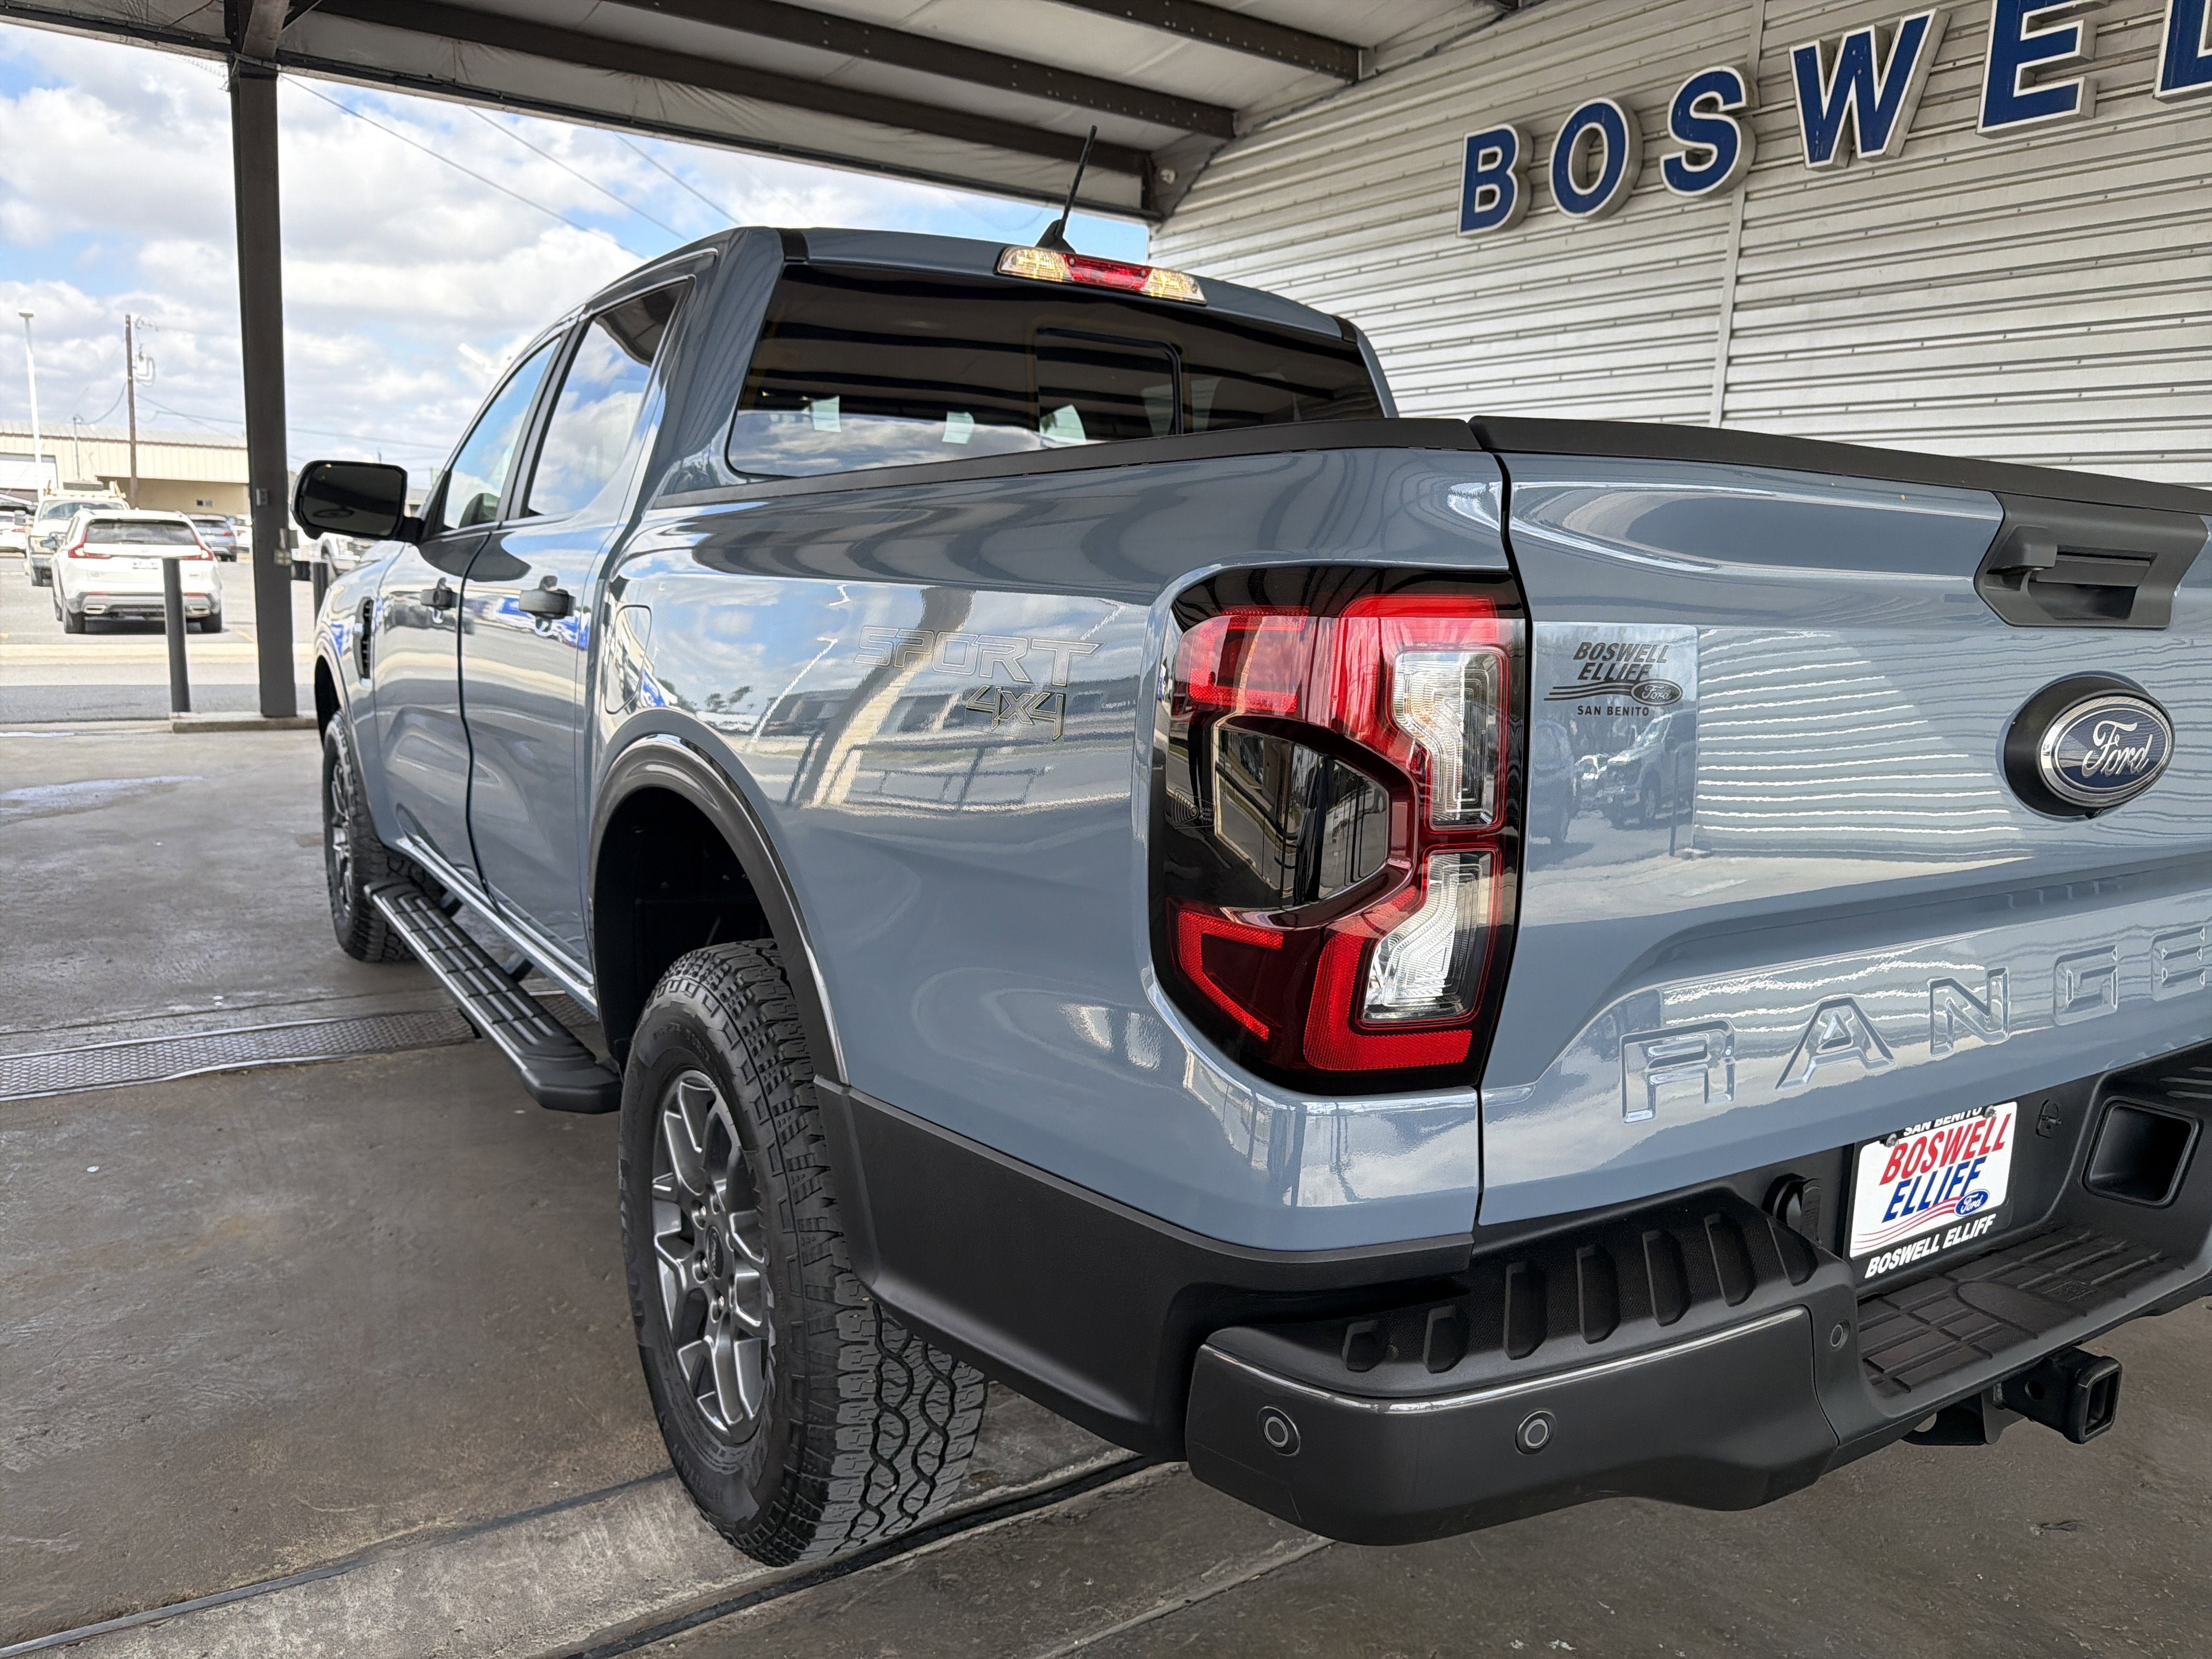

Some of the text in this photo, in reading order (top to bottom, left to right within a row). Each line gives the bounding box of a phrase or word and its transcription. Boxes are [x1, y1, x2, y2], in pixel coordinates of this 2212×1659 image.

[854, 626, 1106, 687] SPORT
[1573, 641, 1669, 663] BOSWELL
[1577, 662, 1652, 681] ELLIFF
[1641, 685, 1672, 701] Ford
[1577, 705, 1649, 716] SAN BENITO
[2081, 720, 2153, 778] Ford
[1903, 1121, 1932, 1136] SAN
[1878, 1113, 2012, 1186] BOSWELL
[1881, 1155, 1988, 1223] ELLIFF
[1960, 1193, 1984, 1214] Ford
[1865, 1214, 1997, 1279] BOSWELL ELLIFF
